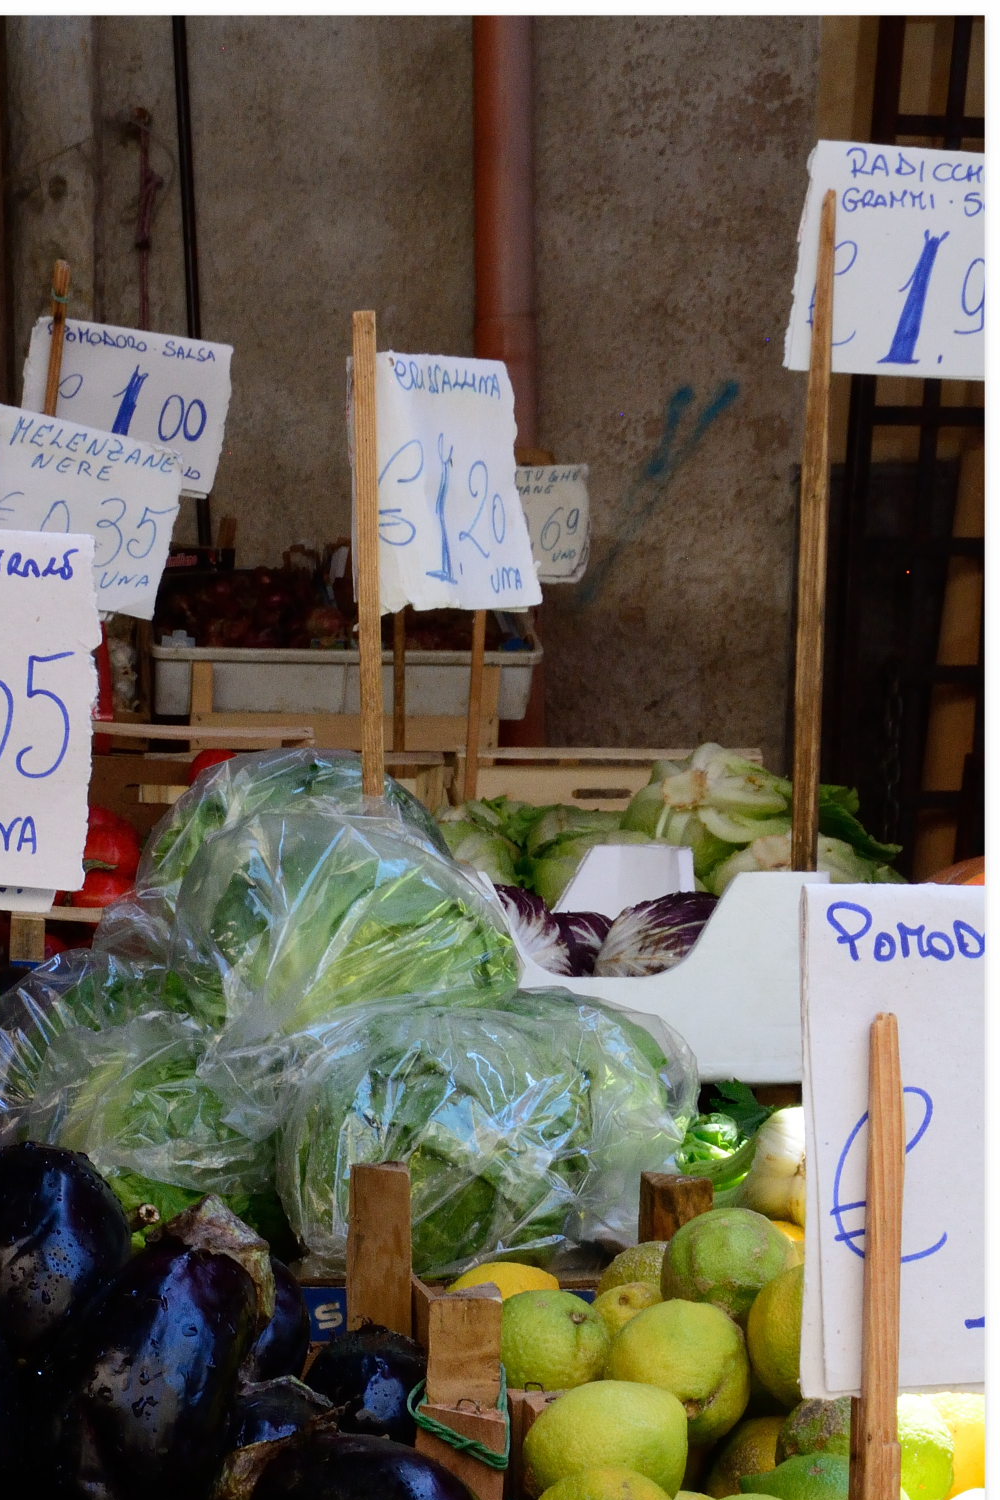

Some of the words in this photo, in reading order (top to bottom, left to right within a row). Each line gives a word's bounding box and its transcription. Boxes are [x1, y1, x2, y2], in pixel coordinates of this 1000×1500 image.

[162, 340, 216, 362] SALSA
[30, 453, 114, 482] NERE
[99, 571, 150, 589] UNA
